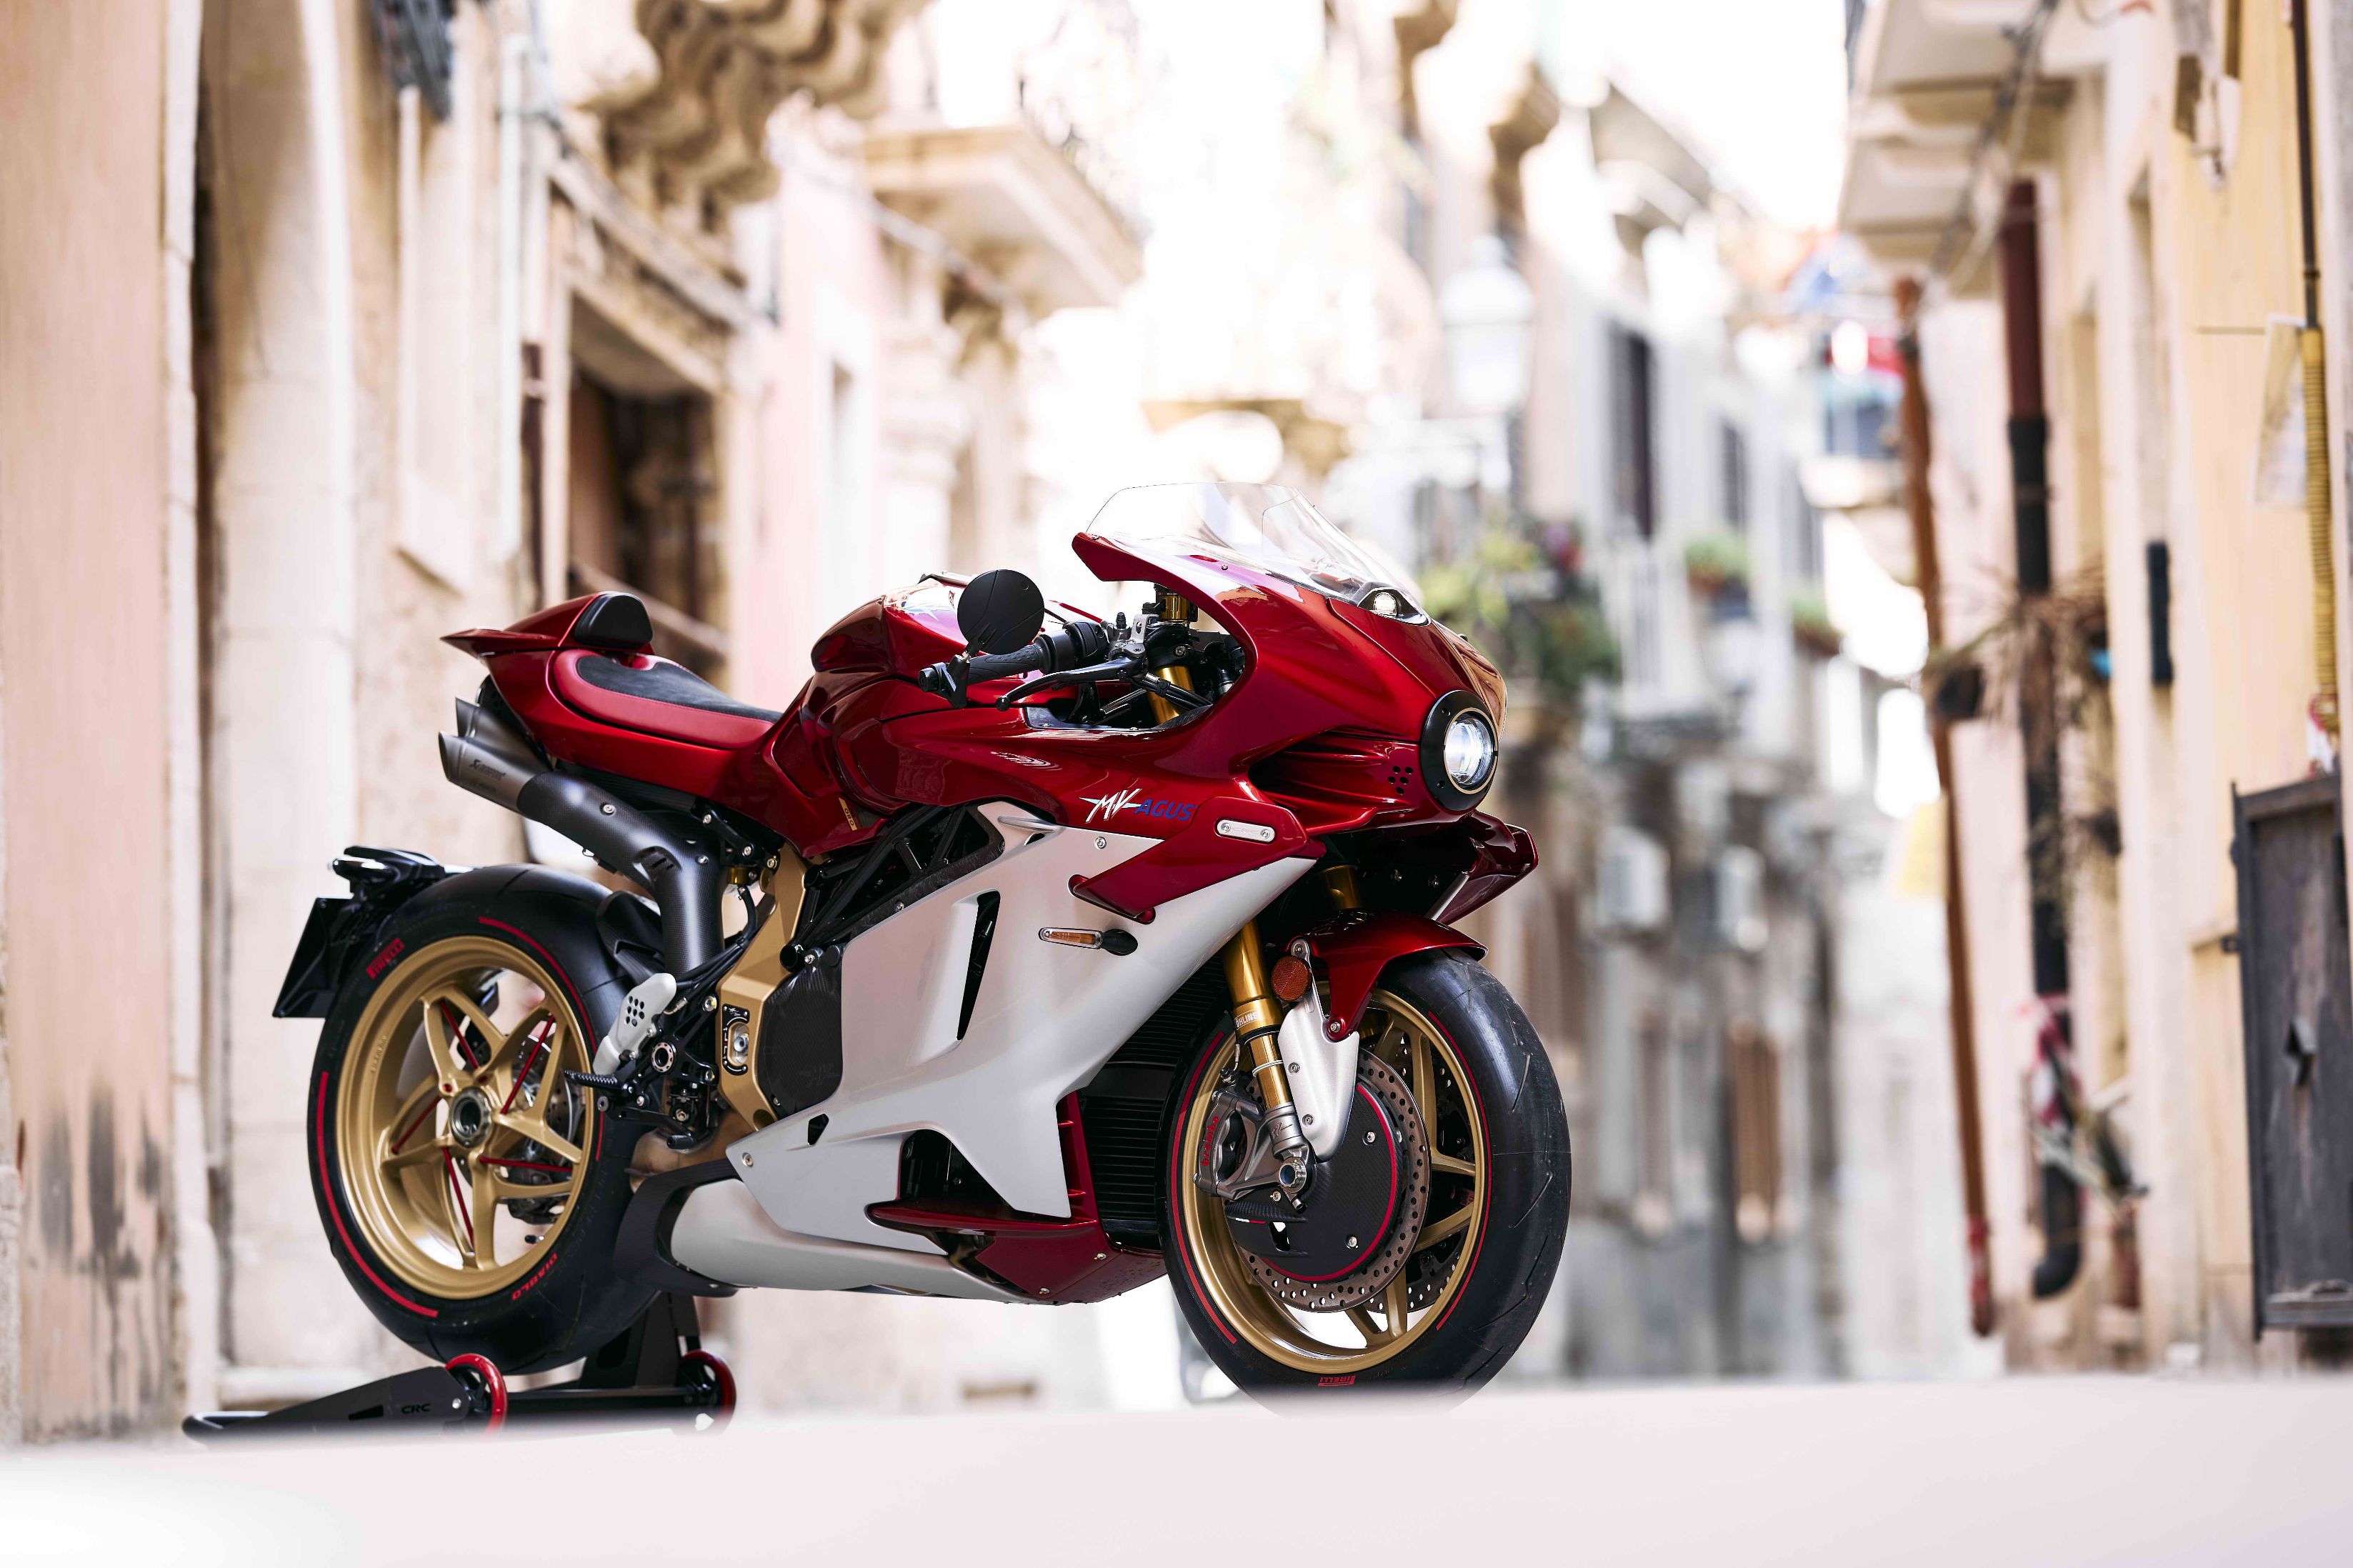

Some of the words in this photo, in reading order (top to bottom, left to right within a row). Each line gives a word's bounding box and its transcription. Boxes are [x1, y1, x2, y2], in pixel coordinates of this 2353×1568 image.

[844, 808, 854, 826] ORO
[1079, 788, 1142, 824] MV
[1133, 798, 1199, 821] AGUS
[1201, 1117, 1219, 1167] brembo
[512, 1252, 557, 1301] DIABLO
[1318, 1375, 1356, 1387] PIRELLI
[401, 1403, 431, 1414] CRC
